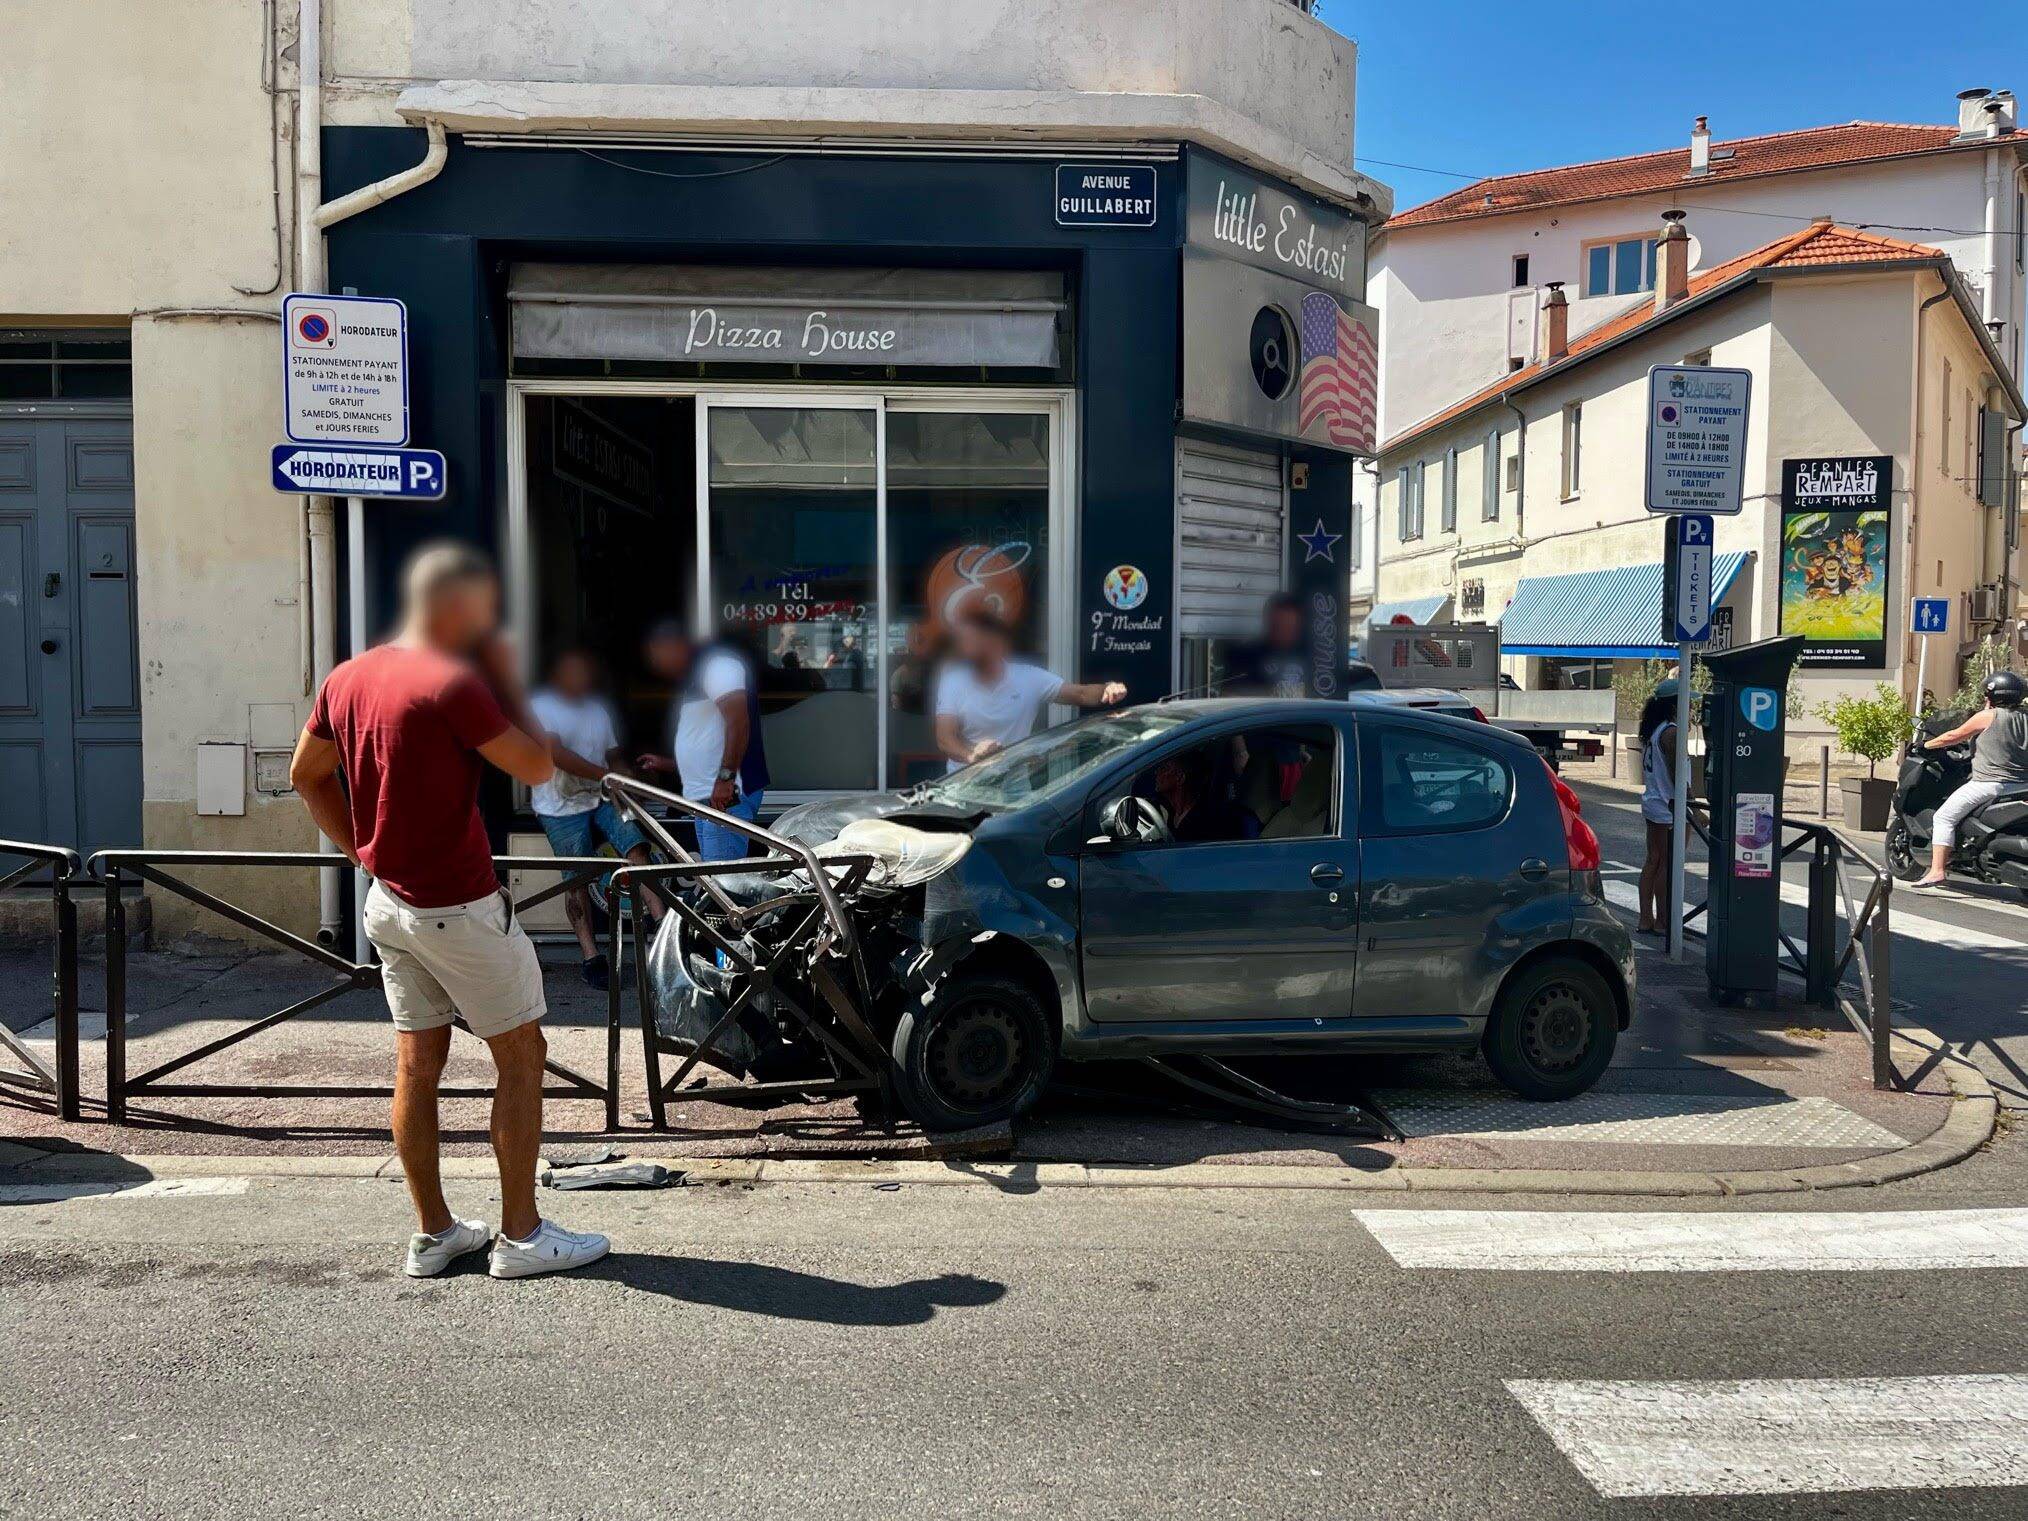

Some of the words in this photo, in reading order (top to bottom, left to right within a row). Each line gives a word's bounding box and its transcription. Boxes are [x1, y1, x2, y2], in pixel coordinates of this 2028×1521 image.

[1082, 176, 1130, 189] AVENUE
[1060, 197, 1152, 214] GUILLABERT
[1275, 205, 1346, 281] Estasi
[341, 325, 398, 338] HORODATEUR
[685, 309, 782, 354] Pizza
[292, 356, 363, 368] STATIONNEMENT
[364, 361, 398, 370] PAYANT
[295, 370, 305, 378] de
[306, 370, 317, 379] 9h
[319, 371, 325, 379] à
[326, 371, 339, 380] 12h
[350, 372, 361, 381] de
[362, 373, 375, 382] 14h
[377, 374, 383, 382] à
[384, 374, 397, 383] 18h
[312, 384, 339, 393] LIMITE
[340, 384, 346, 393] à
[347, 385, 352, 393] 2
[353, 385, 380, 395] heures
[329, 398, 364, 407] GRATUIT
[301, 409, 341, 420] SAMEDIS,
[343, 411, 392, 421] DIMANCHES
[1684, 406, 1741, 416] STATIONNEMENT
[1698, 416, 1727, 425] PAYANT
[325, 424, 351, 433] JOURS
[353, 425, 379, 434] FERIES
[1667, 432, 1676, 440] DE
[1709, 434, 1730, 442] 12H00
[1678, 442, 1699, 450] 14H00
[1665, 452, 1689, 461] LIMITÉ
[1697, 453, 1701, 461] 2
[1702, 454, 1729, 463] HEURES
[290, 461, 399, 481] HORODATEUR
[409, 461, 433, 489] P
[1667, 470, 1725, 480] STATIONNEMENT
[1800, 461, 1874, 481] DERNIER
[1681, 479, 1710, 488] GRATUIT
[1799, 472, 1876, 493] REMPART
[1692, 491, 1725, 499] DIMANCHES
[1686, 520, 1701, 542] P
[102, 552, 113, 567] 2
[776, 583, 814, 600] Tél.
[1690, 553, 1700, 624] TICKETS
[1112, 615, 1163, 630] Mondial
[1104, 637, 1151, 653] Français
[1313, 592, 1337, 697] ouse
[1750, 692, 1772, 723] P
[1736, 745, 1752, 757] 80
